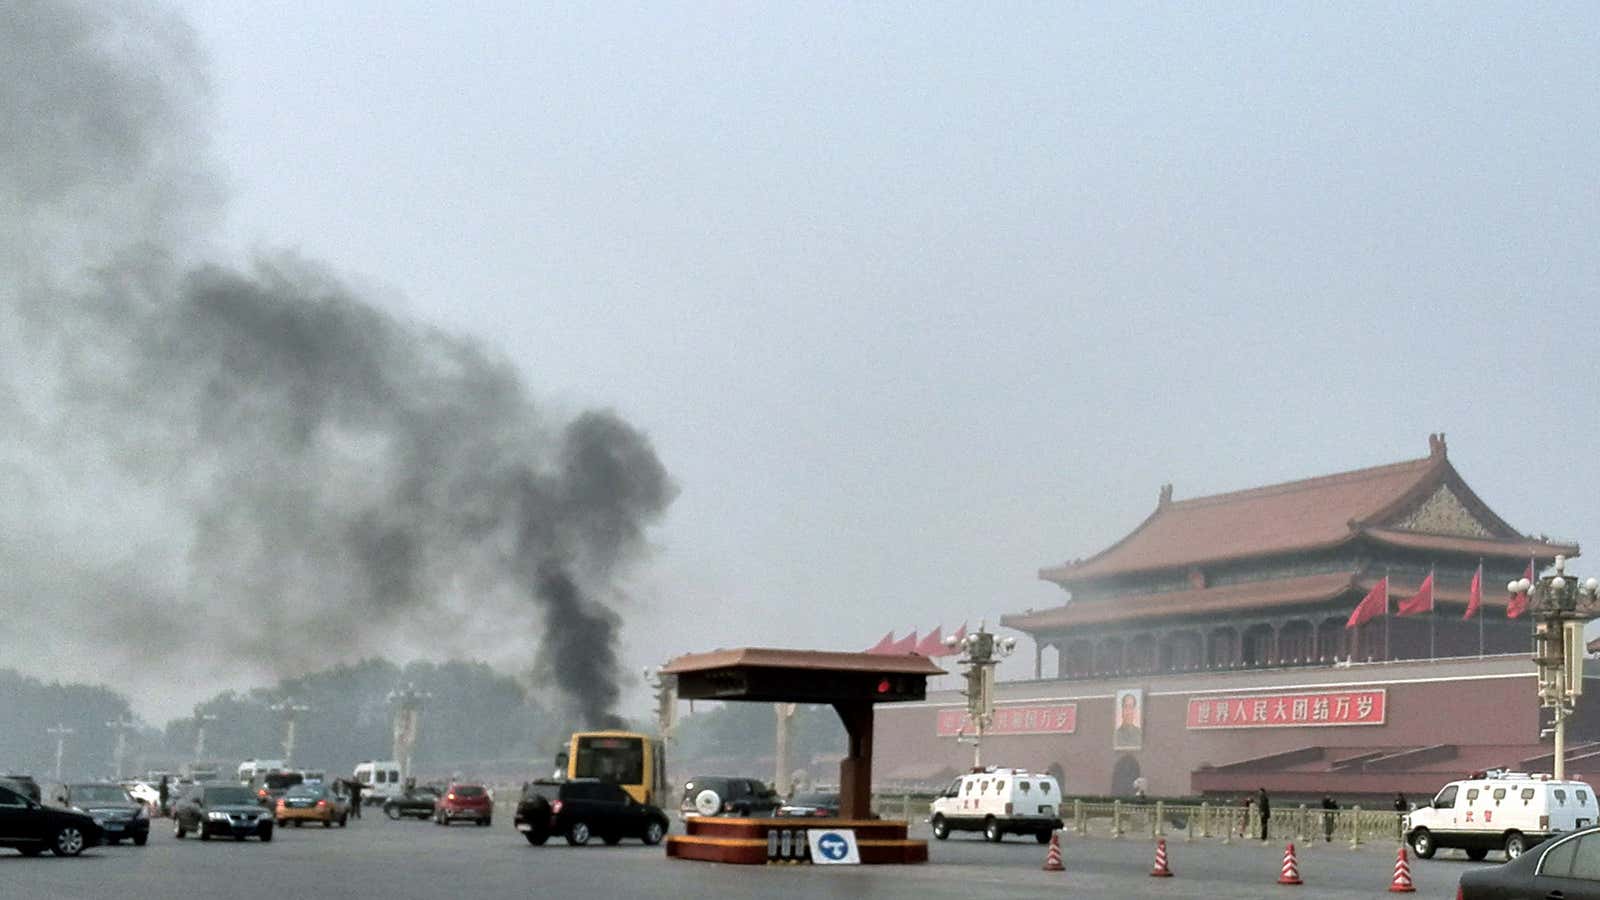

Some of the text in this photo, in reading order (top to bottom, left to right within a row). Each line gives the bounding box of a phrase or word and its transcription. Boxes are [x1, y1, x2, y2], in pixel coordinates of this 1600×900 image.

[1197, 696, 1373, 723] 世界人民大团结万岁
